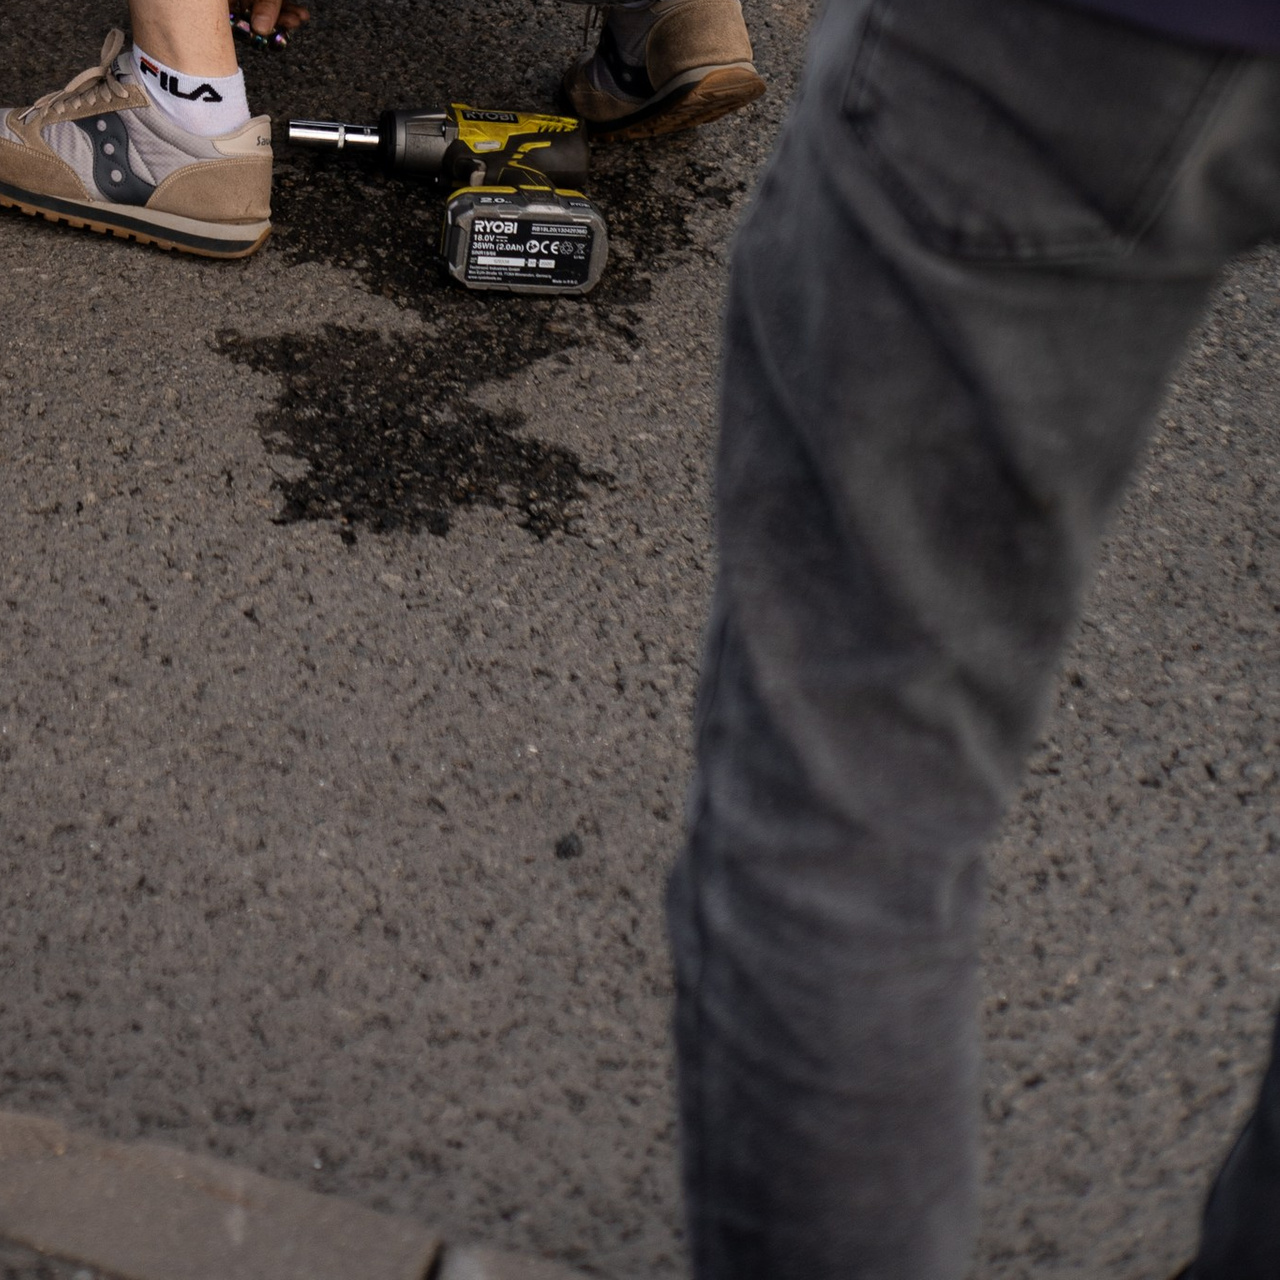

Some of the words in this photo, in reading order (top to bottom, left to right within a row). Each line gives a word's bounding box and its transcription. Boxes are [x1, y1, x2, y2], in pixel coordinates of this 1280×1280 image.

[139, 56, 223, 103] FILA
[465, 111, 515, 121] RYOBI
[474, 220, 518, 234] RYOBI
[473, 234, 495, 242] 18.0V
[472, 242, 495, 250] 36Wh
[496, 243, 525, 253] (2.0Ah)
